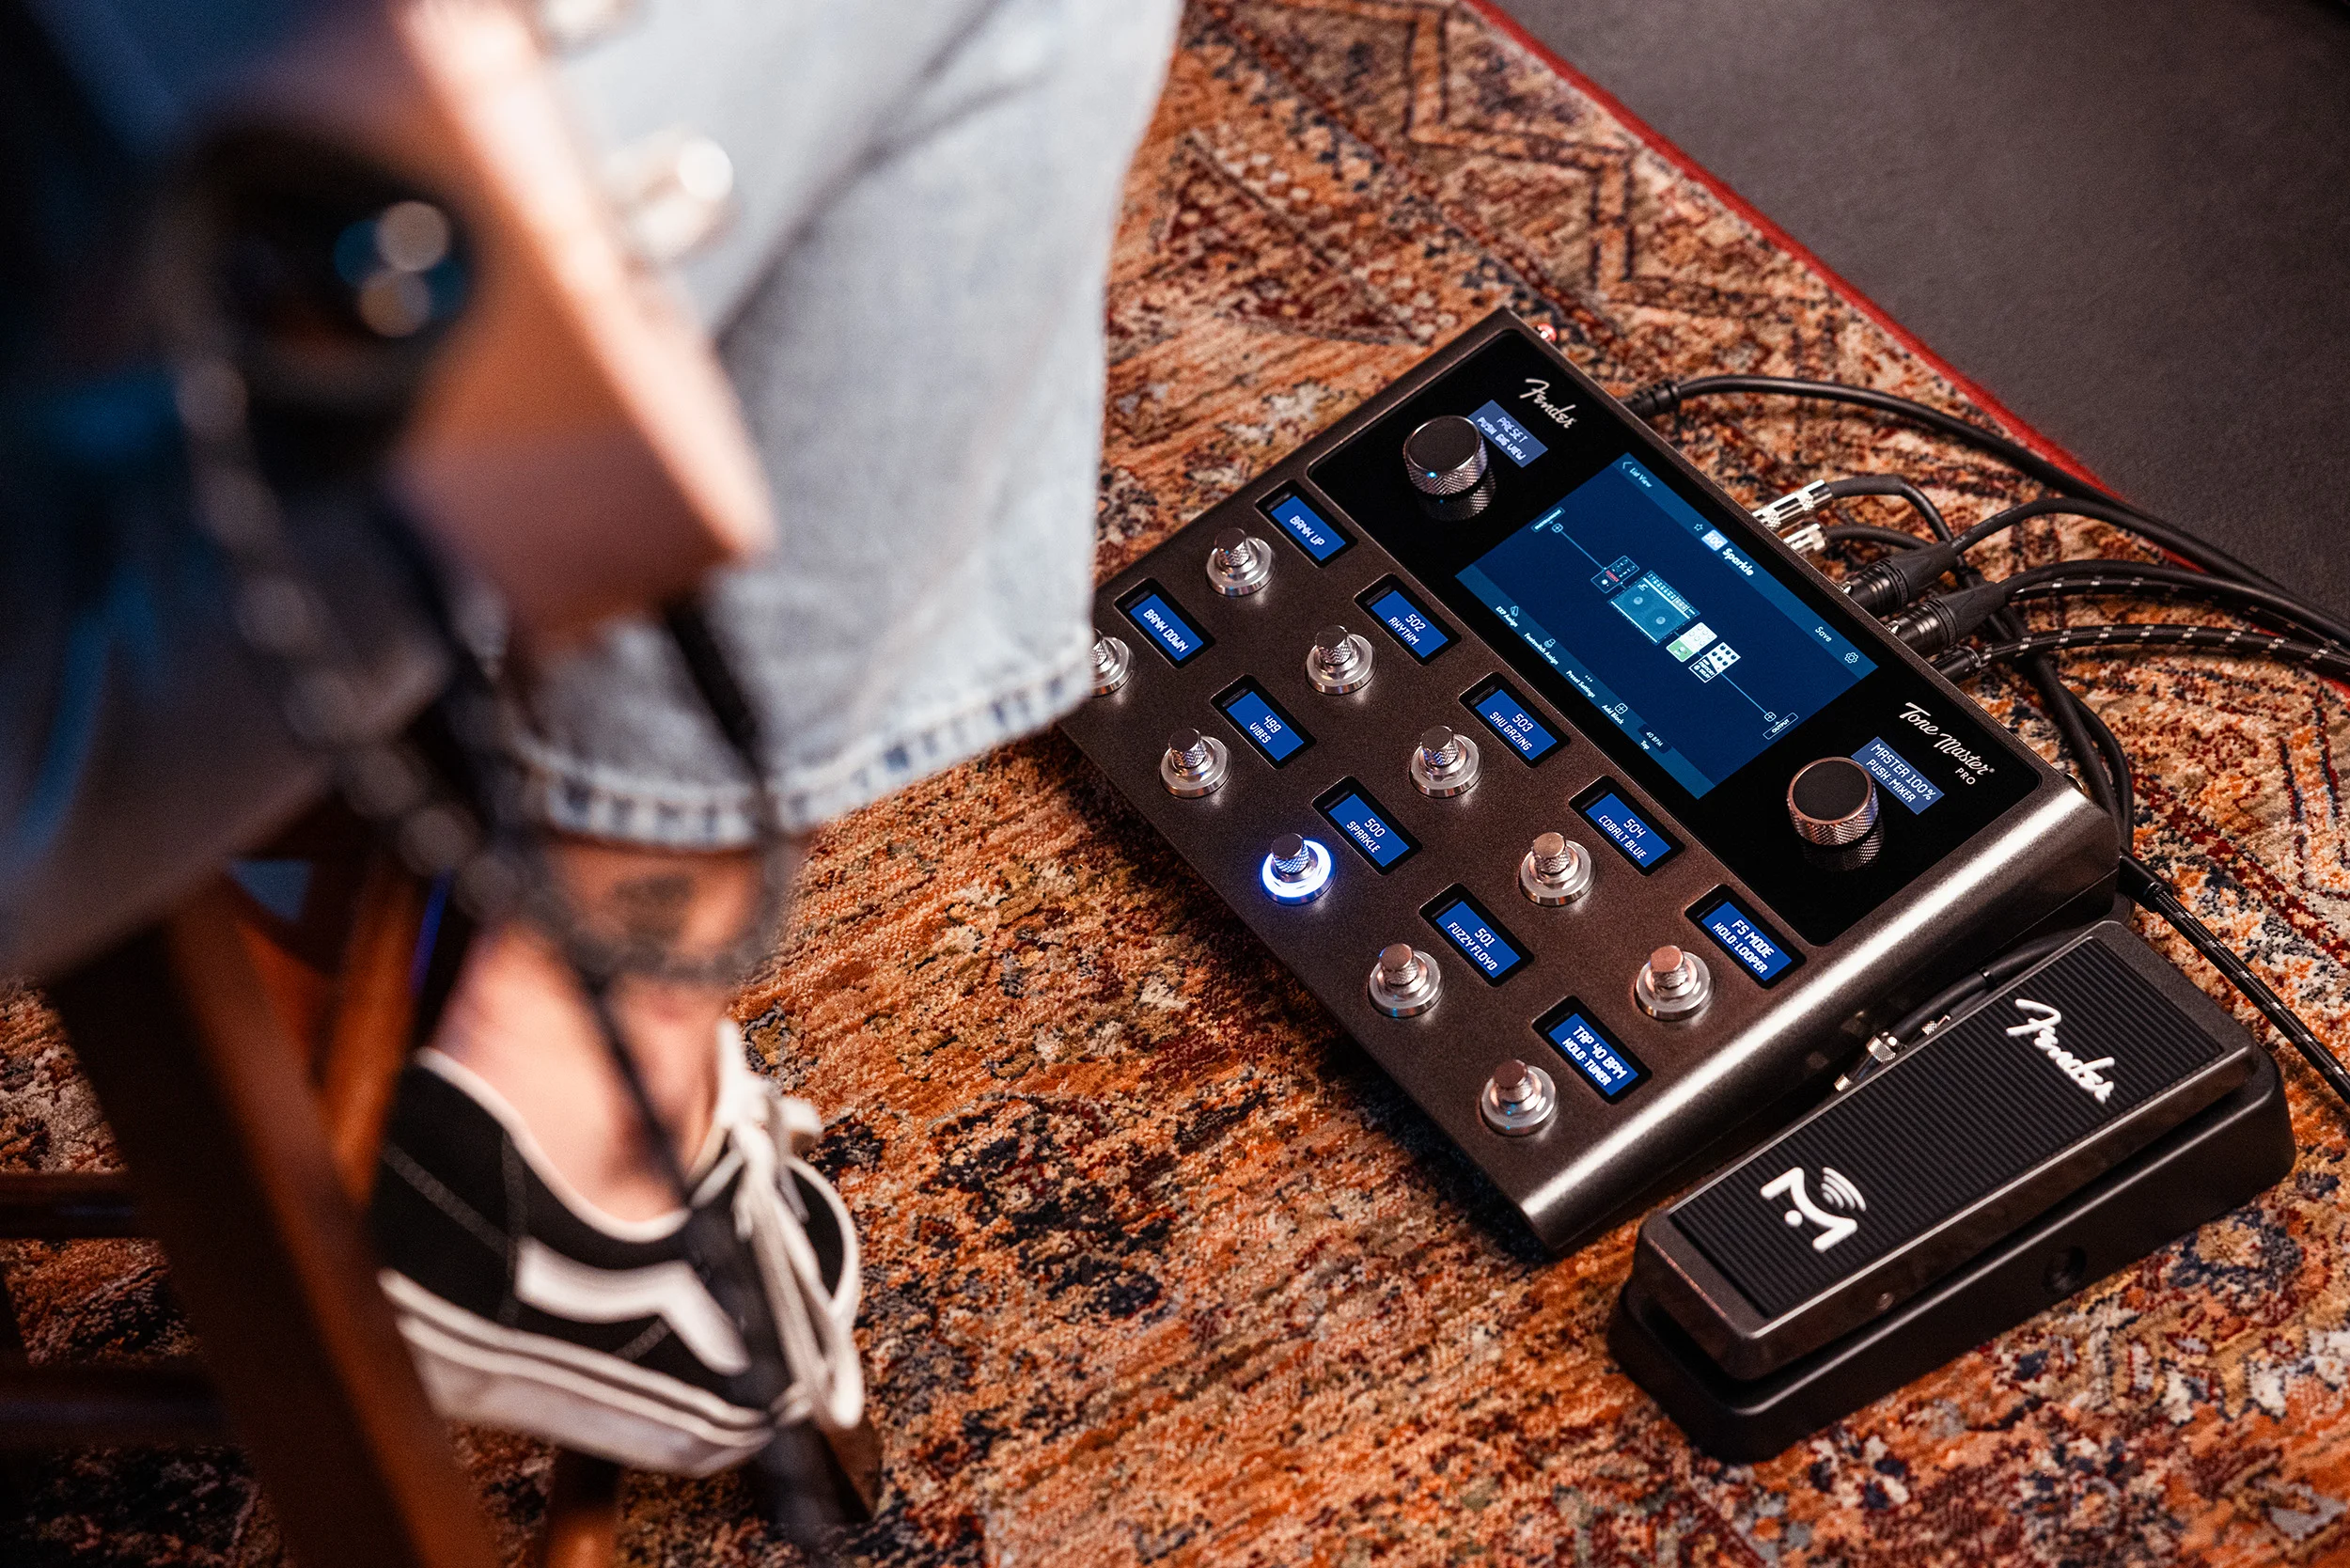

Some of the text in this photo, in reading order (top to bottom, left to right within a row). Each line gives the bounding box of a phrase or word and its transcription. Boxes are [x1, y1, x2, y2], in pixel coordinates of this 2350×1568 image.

[1520, 378, 1576, 429] Fender
[1496, 416, 1528, 443] PRESET
[1290, 515, 1325, 545] BANK UP
[1704, 531, 1754, 576] 500 Sparkle
[1143, 608, 1189, 652] BANK DOWN
[1388, 617, 1419, 646] RHYTHM
[1405, 613, 1426, 632] 502
[1815, 626, 1832, 643] Save
[1566, 670, 1580, 684] Preset
[1263, 714, 1281, 733] 499
[1512, 713, 1533, 732] 503
[1602, 704, 1624, 725] Add Block
[1772, 718, 1790, 733] OUTPUT
[1899, 702, 1939, 735] Tone
[1249, 722, 1272, 744] VIBES
[1489, 712, 1532, 751] SHU GAZING
[1640, 740, 1650, 750] Tap
[1652, 736, 1663, 747] BPM
[1871, 744, 1936, 800] MASTER 100%
[1955, 767, 1976, 785] PRO
[1346, 821, 1381, 854] SPARKLE
[1364, 817, 1385, 838] 500
[1598, 815, 1647, 859] COBALT BLUE
[1623, 818, 1646, 839] 504
[1448, 922, 1497, 970] FUZZY FLOYD
[1474, 928, 1496, 948] 501
[1731, 919, 1775, 958] FS MODE
[1573, 1025, 1627, 1079] TAP 40 BPM
[2006, 998, 2116, 1103] Fender
